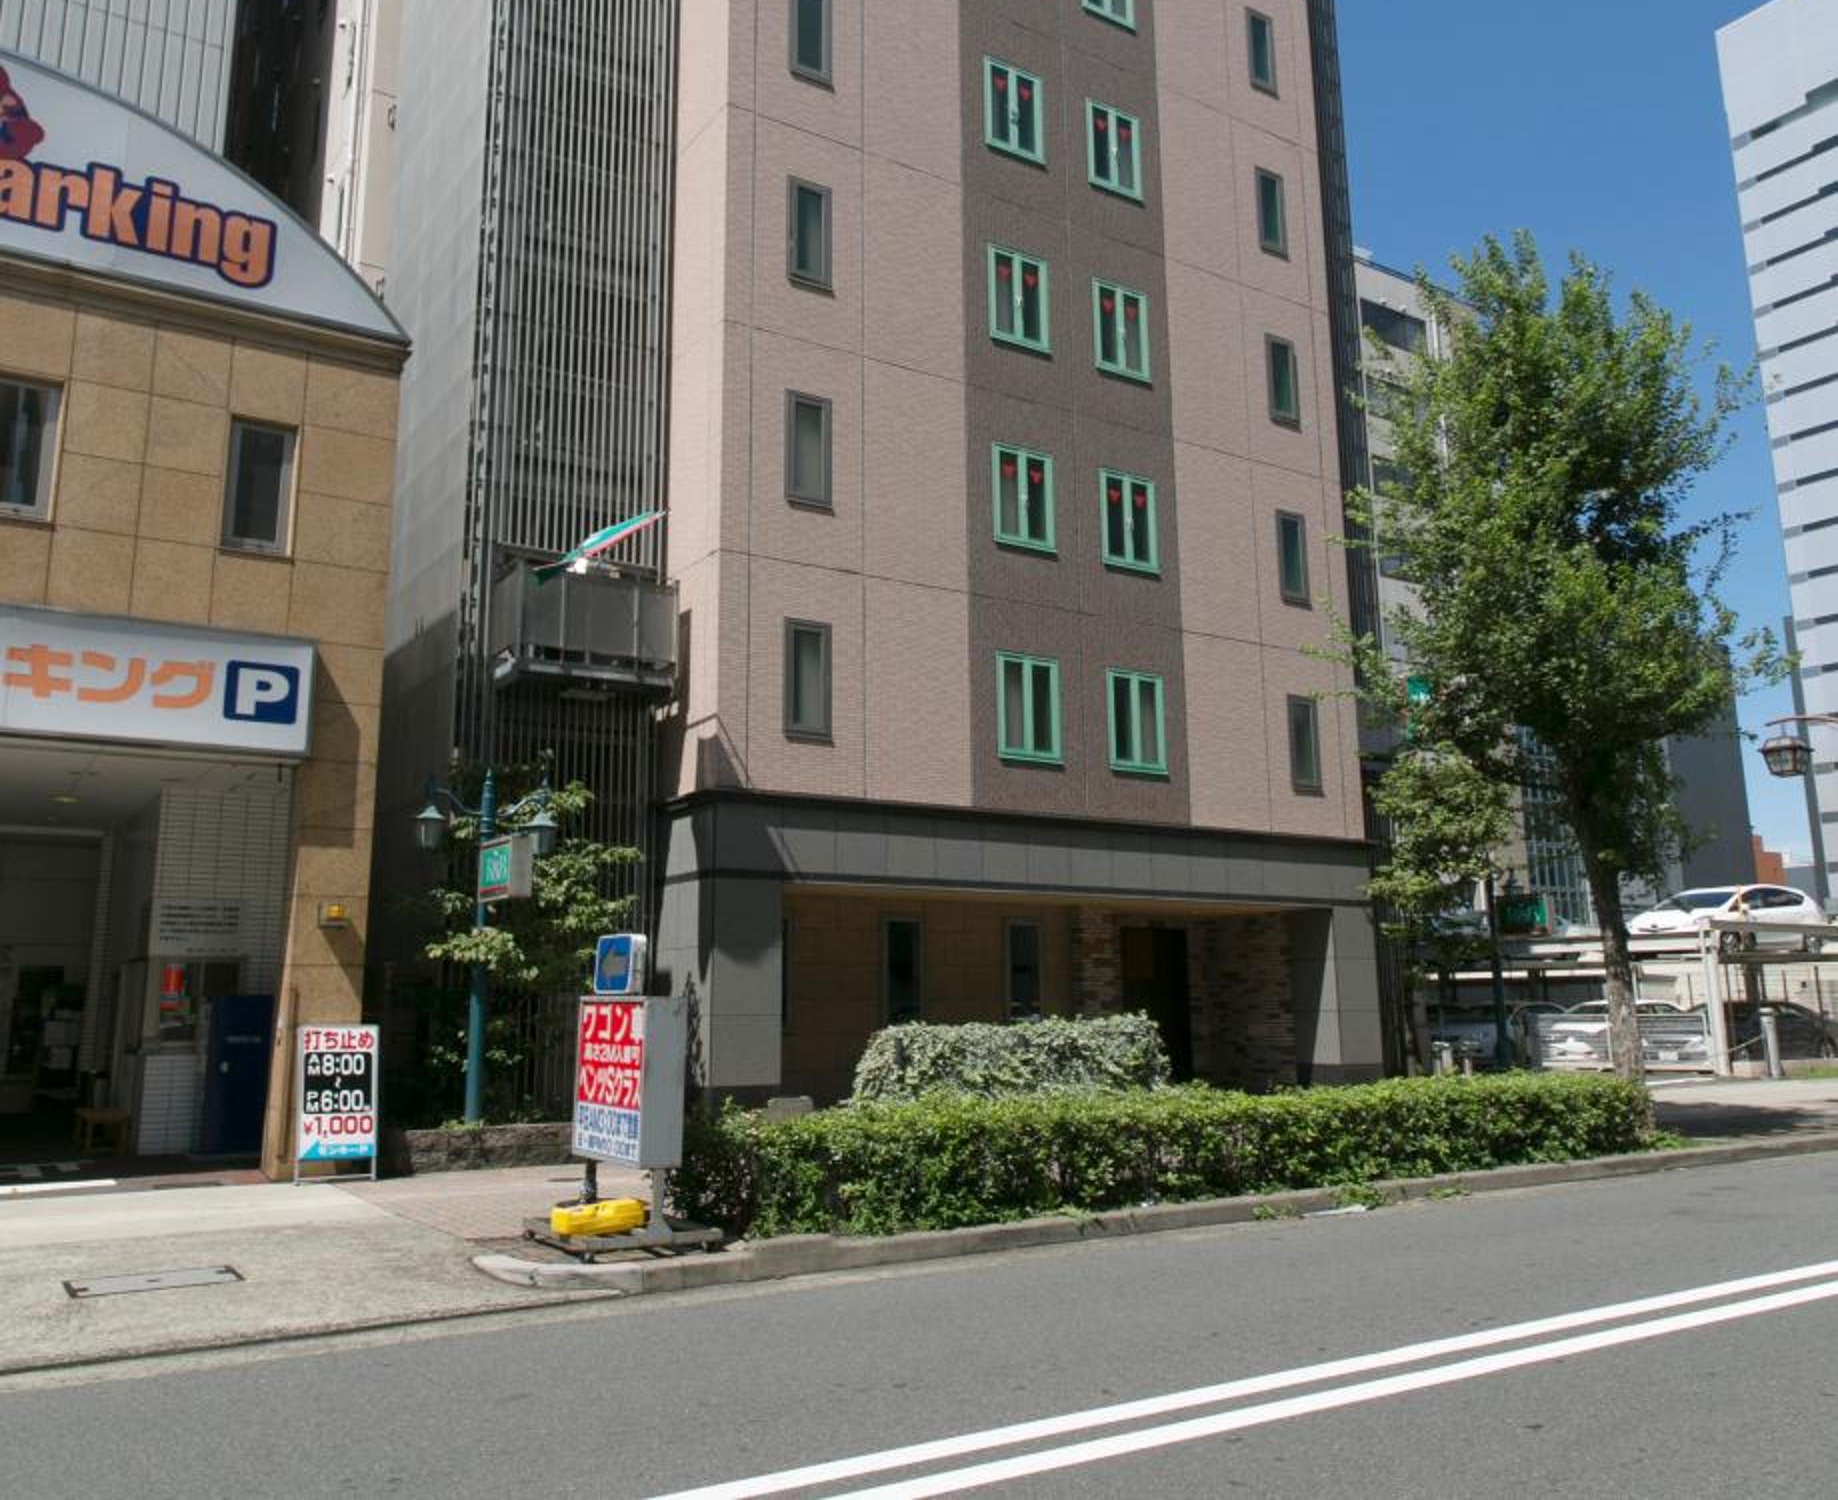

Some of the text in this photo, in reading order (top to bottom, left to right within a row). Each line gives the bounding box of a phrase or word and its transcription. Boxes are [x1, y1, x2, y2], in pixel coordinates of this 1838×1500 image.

[3, 644, 290, 716] キング P
[303, 1030, 374, 1051] 打ち止め
[322, 1053, 365, 1076] 8:00
